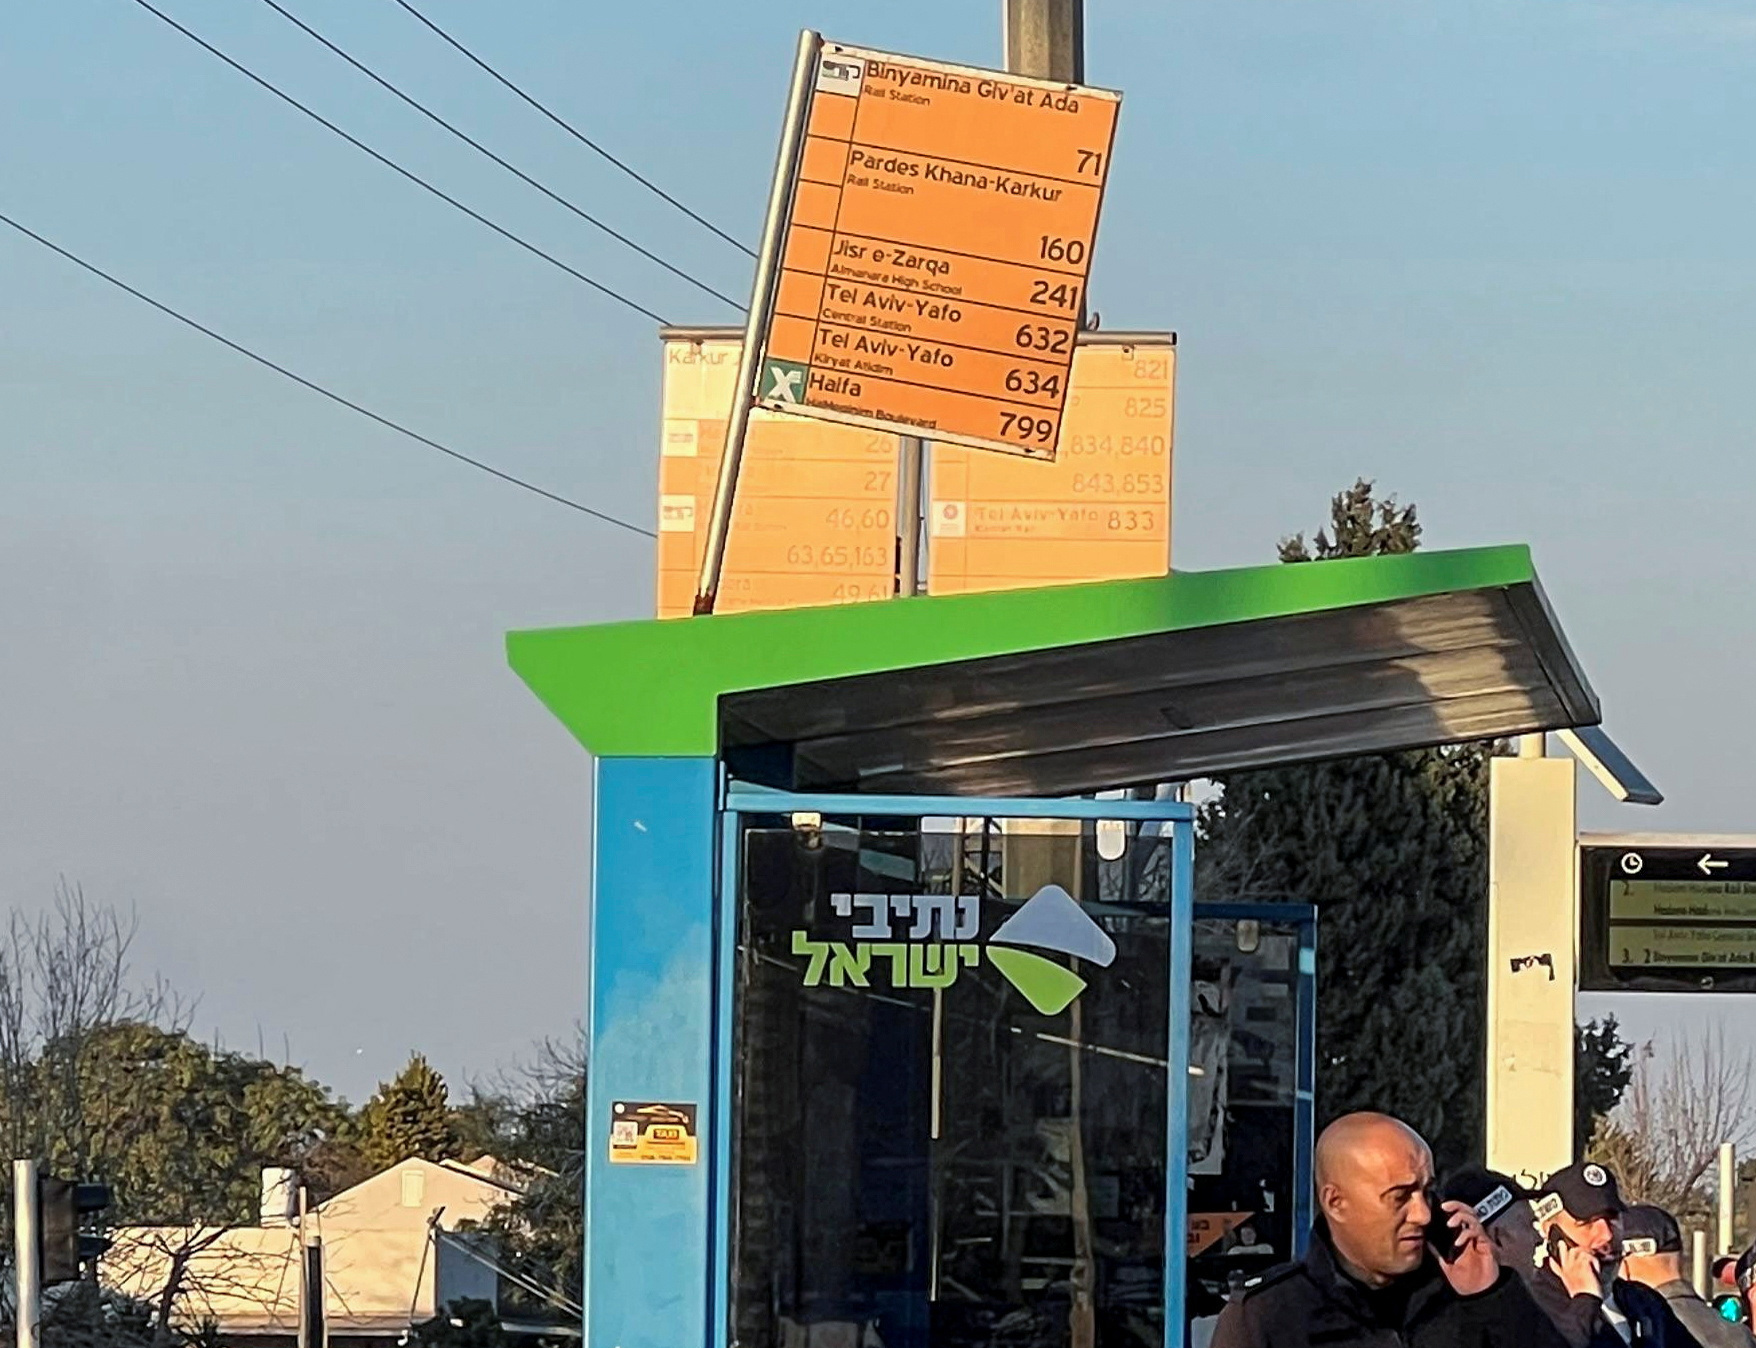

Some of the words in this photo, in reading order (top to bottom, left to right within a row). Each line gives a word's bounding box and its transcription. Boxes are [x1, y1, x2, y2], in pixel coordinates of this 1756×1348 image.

[864, 84, 886, 99] Rail
[889, 89, 930, 106] Station
[866, 61, 970, 94] Binyamina
[978, 79, 1033, 107] Giv'at
[1040, 91, 1079, 114] Ada
[850, 150, 919, 177] Pardes
[925, 164, 1063, 202] Khana-Karkur
[1076, 149, 1103, 176] 71
[847, 173, 869, 188] Rail
[872, 178, 914, 195] Station
[834, 239, 867, 259] Jisr
[873, 249, 950, 276] e-Zarqa
[1039, 235, 1085, 265] 160
[922, 279, 962, 295] School
[1030, 280, 1078, 311] 241
[827, 284, 857, 305] Tel
[863, 290, 962, 323] Aviv-Yafo
[870, 315, 912, 333] Station
[819, 328, 849, 349] Tel
[854, 335, 954, 368] Aviv-Yafo
[1016, 324, 1070, 355] 632
[1005, 368, 1060, 399] 634
[1134, 359, 1168, 381] 821
[808, 372, 862, 397] Haifa
[1124, 397, 1167, 419] 825
[999, 411, 1053, 443] 799
[864, 471, 893, 492] 27
[826, 508, 890, 531] 46,60
[1107, 511, 1155, 531] 833
[787, 545, 889, 569] 63,65,163
[830, 893, 980, 940] נתיבי
[792, 930, 980, 989] ישראל
